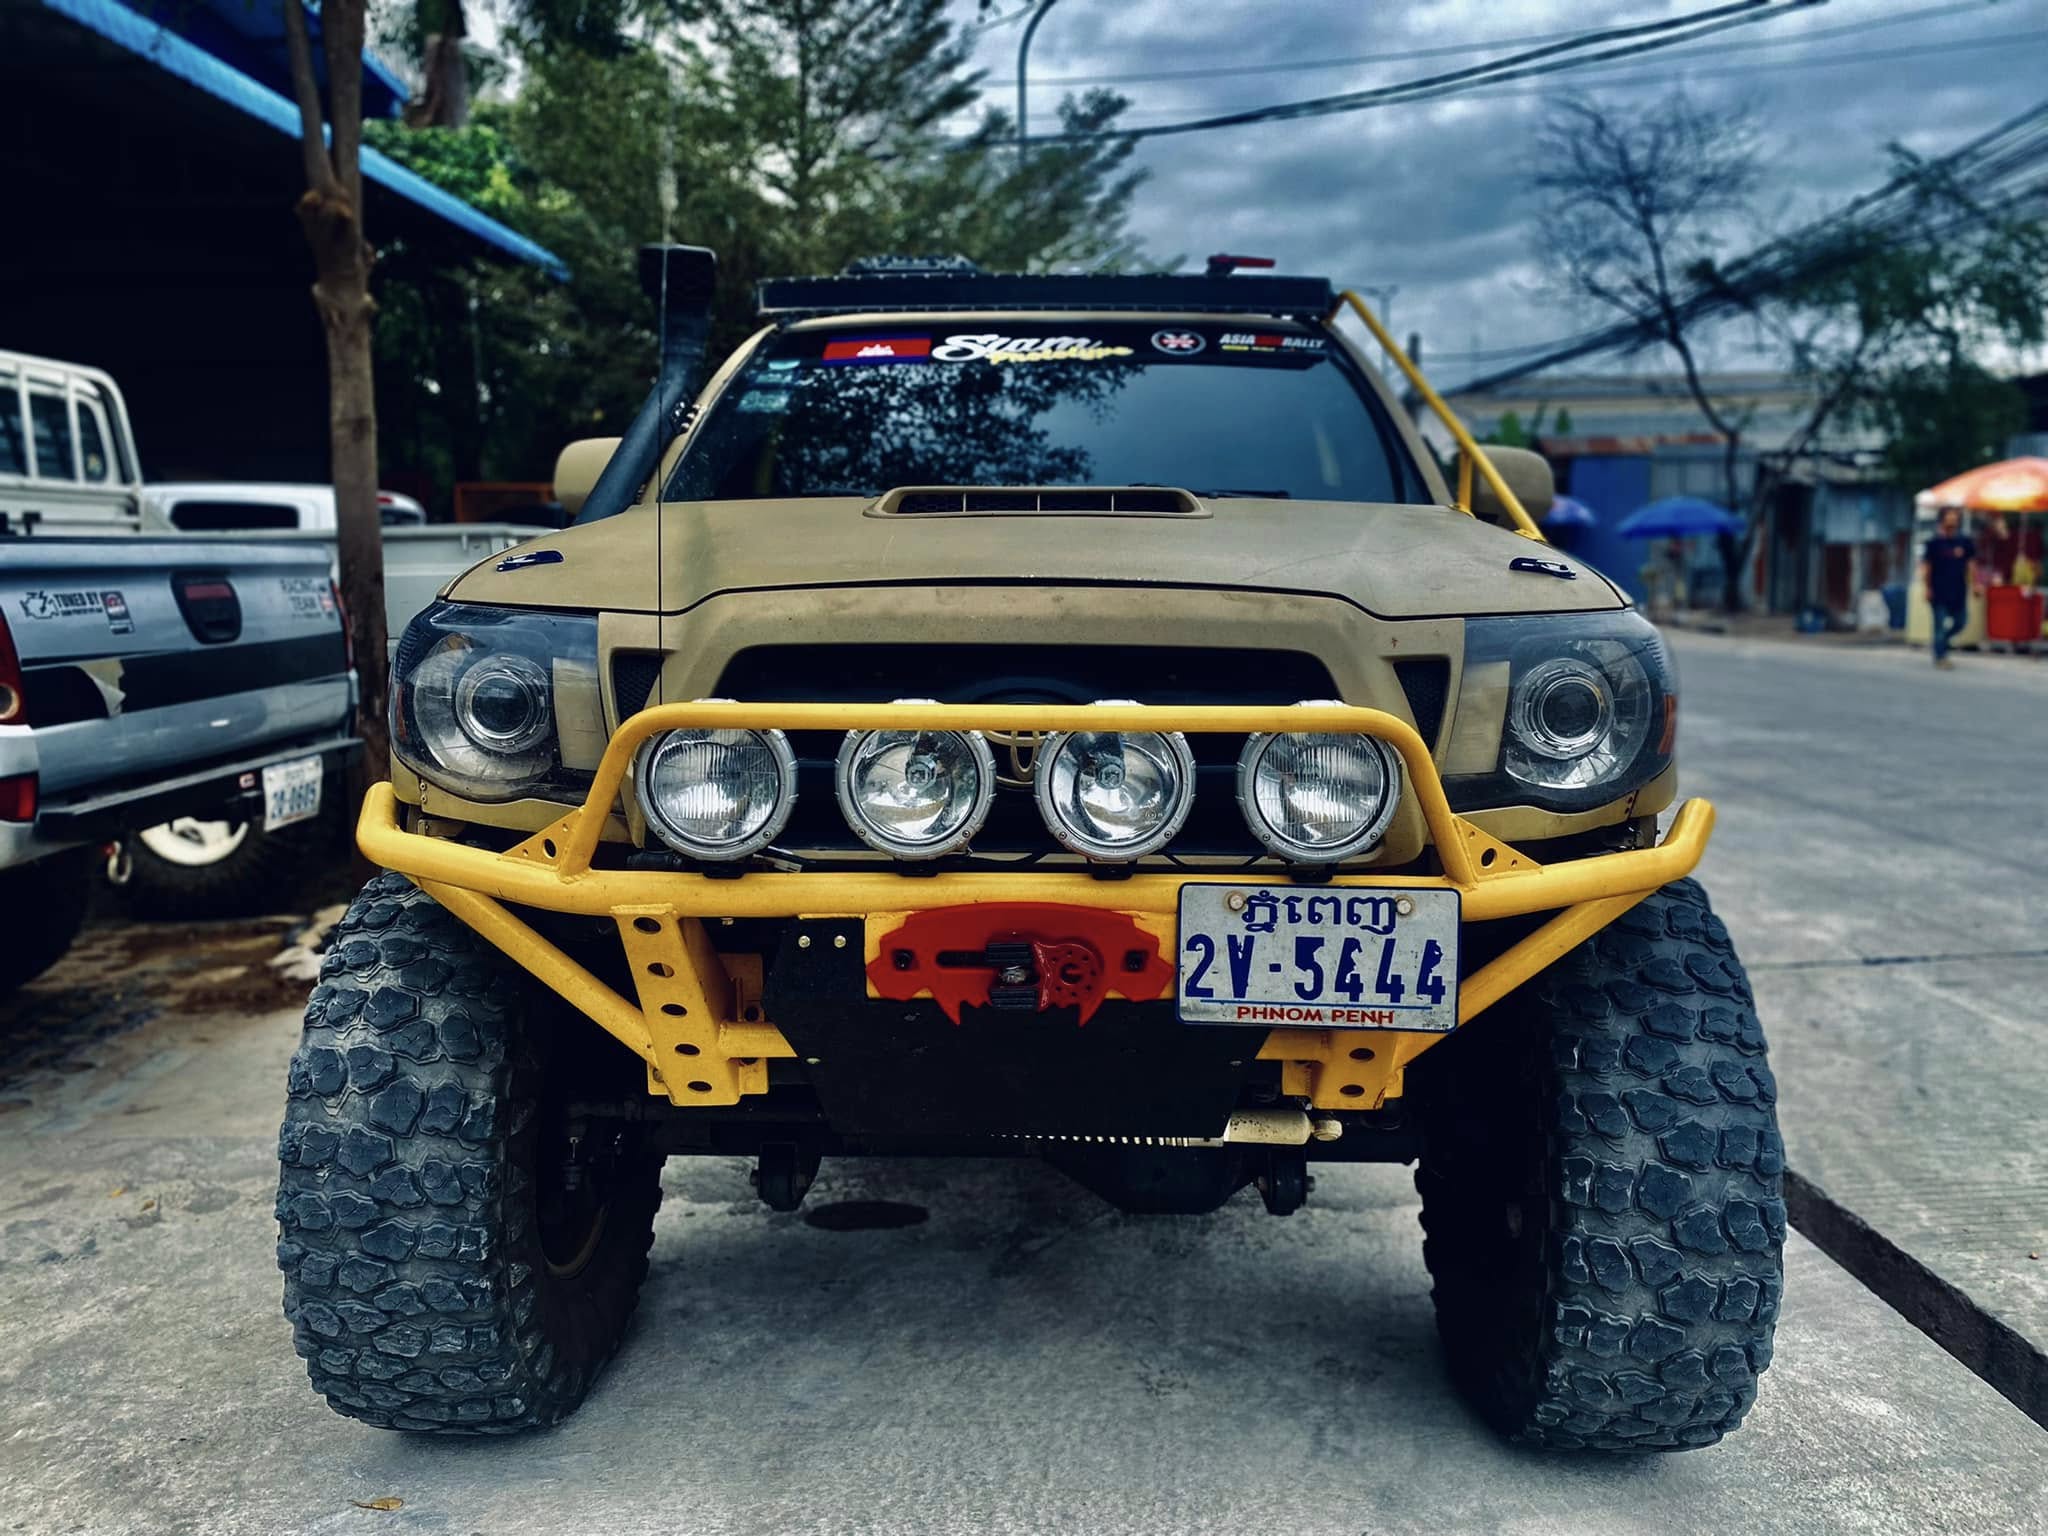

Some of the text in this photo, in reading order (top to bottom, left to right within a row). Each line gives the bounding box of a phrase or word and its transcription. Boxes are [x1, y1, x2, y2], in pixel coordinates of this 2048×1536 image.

[1219, 333, 1257, 346] ASIA
[1281, 336, 1325, 349] RALLY
[1241, 889, 1397, 936] ភ្នំពេញ
[1236, 1005, 1395, 1025] PHNOM PENH
